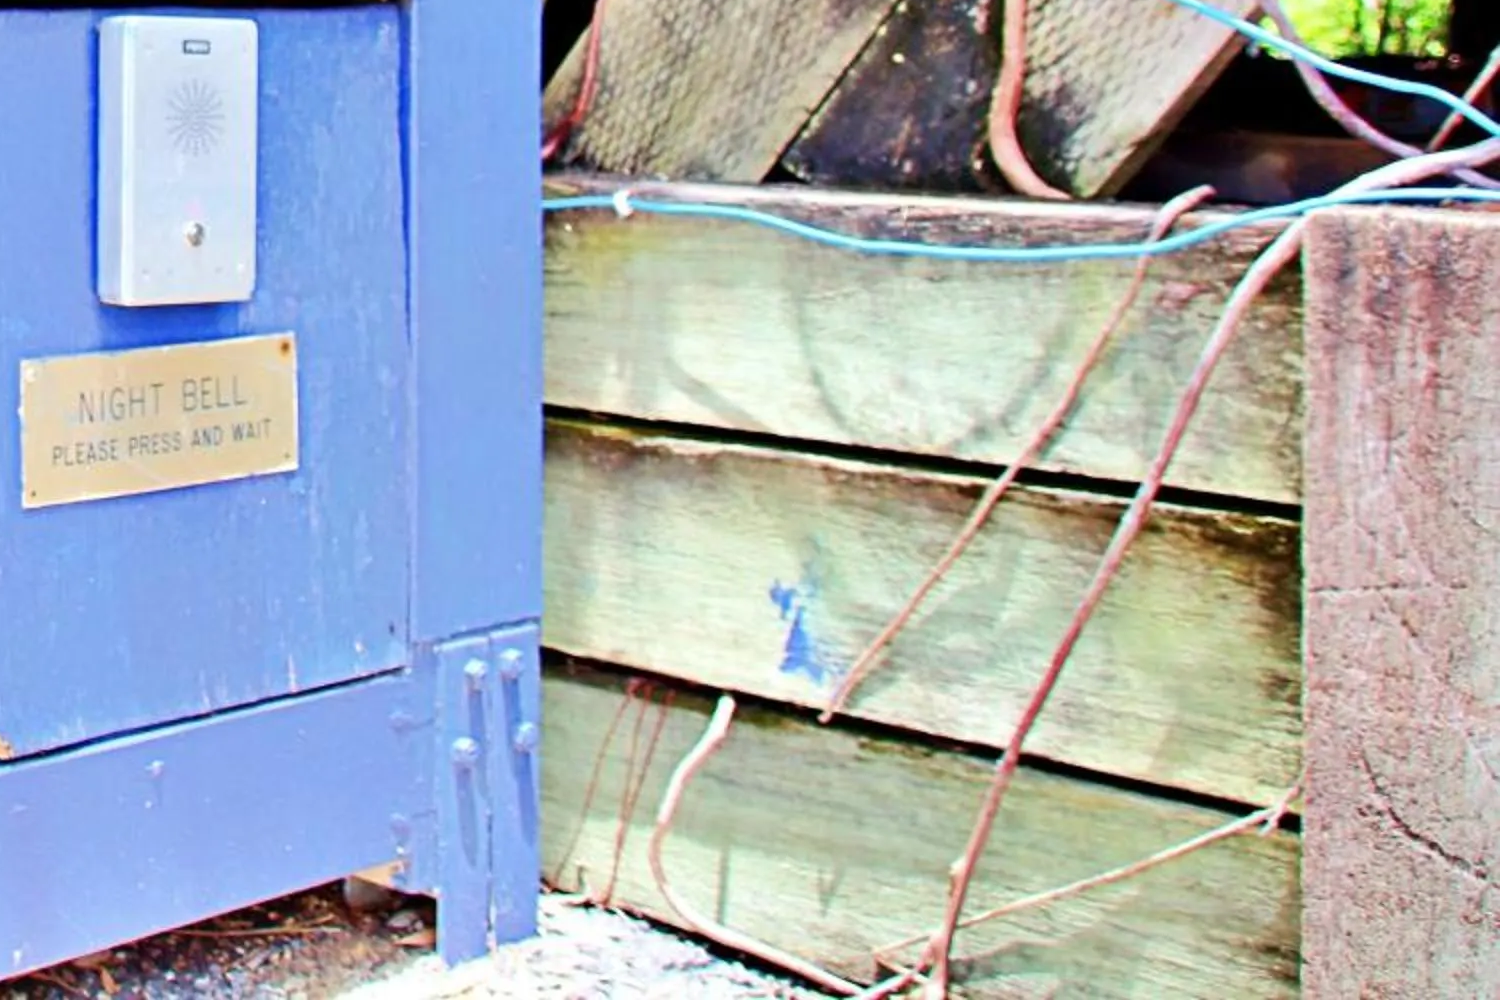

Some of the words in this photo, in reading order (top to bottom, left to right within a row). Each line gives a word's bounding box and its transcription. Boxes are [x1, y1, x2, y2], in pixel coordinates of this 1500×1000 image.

[77, 383, 164, 425] NIGHT
[182, 375, 248, 412] BELL
[52, 438, 119, 466] PLEASE
[128, 430, 182, 457] PRESS
[190, 425, 224, 448] AND
[232, 418, 272, 442] WAIT
